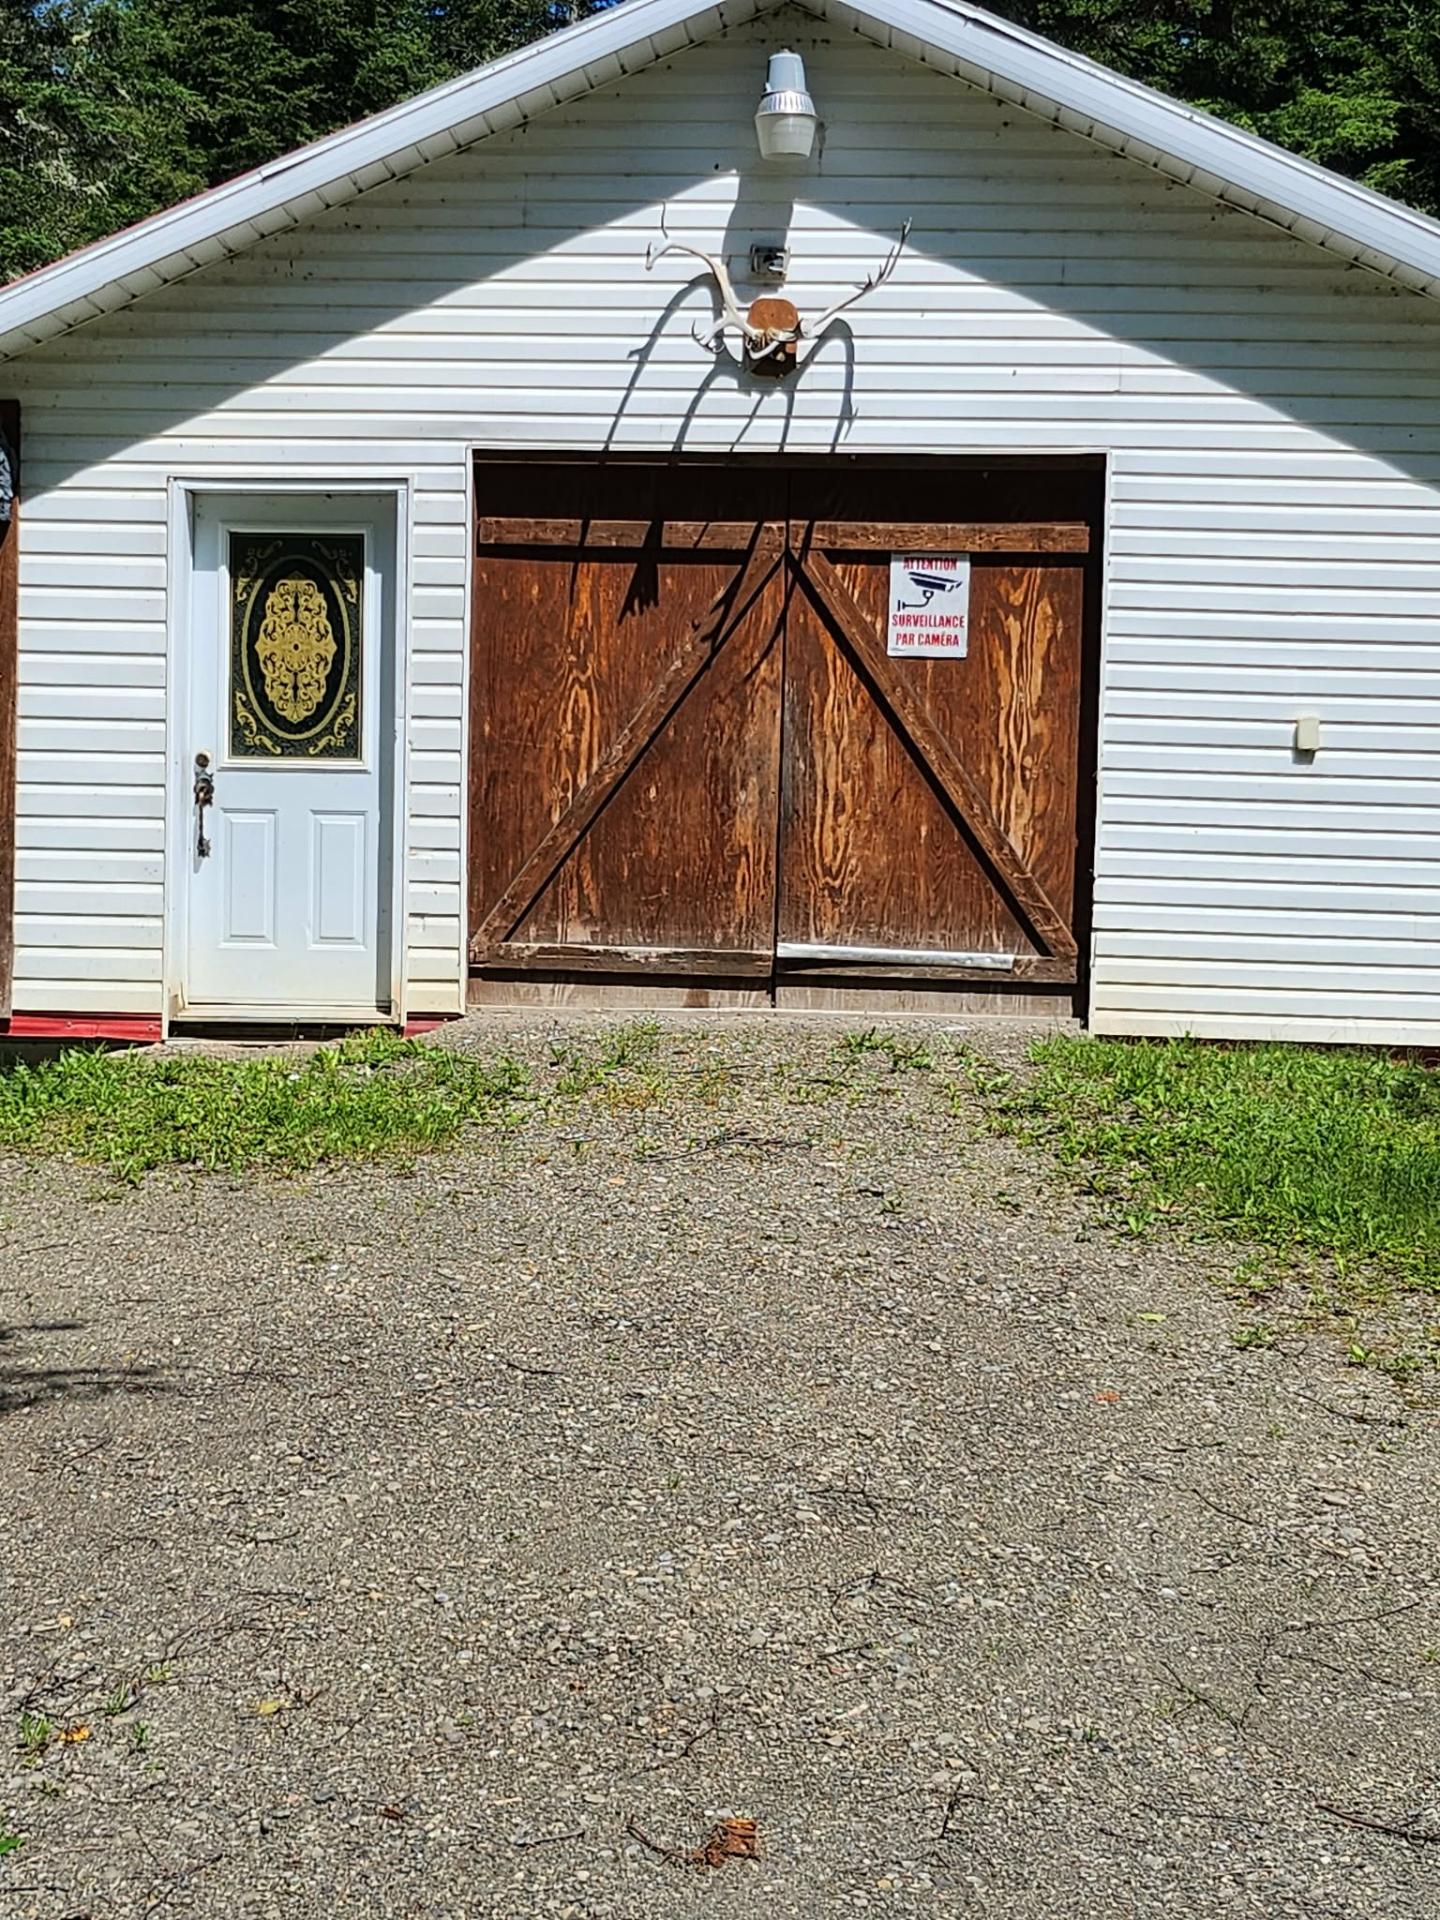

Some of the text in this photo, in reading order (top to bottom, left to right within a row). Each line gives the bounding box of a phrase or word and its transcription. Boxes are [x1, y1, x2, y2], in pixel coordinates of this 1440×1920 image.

[903, 557, 958, 571] ATTENTION
[892, 614, 965, 628] SURVEILLANCE
[896, 630, 960, 647] PAR CAMÉRA
